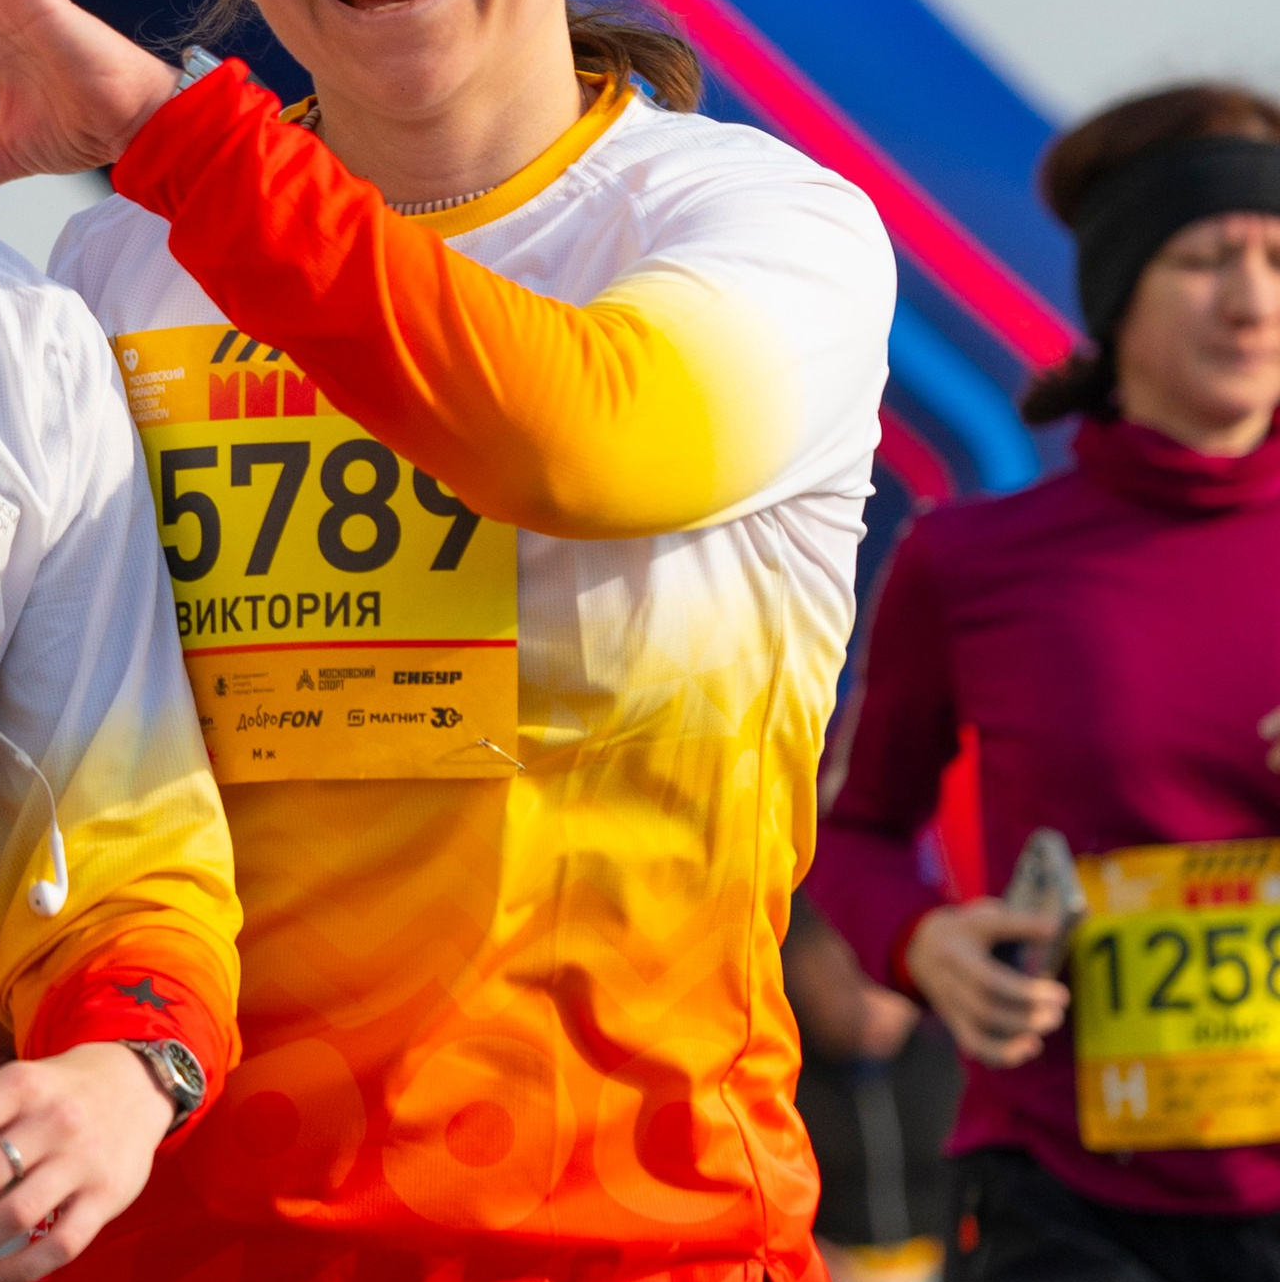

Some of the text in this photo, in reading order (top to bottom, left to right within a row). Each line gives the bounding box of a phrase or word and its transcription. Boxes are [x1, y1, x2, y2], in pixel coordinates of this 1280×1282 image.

[177, 590, 382, 636] ВИКТОРИЯ
[392, 670, 463, 686] СИБУР
[369, 712, 427, 724] МАГНИТ
